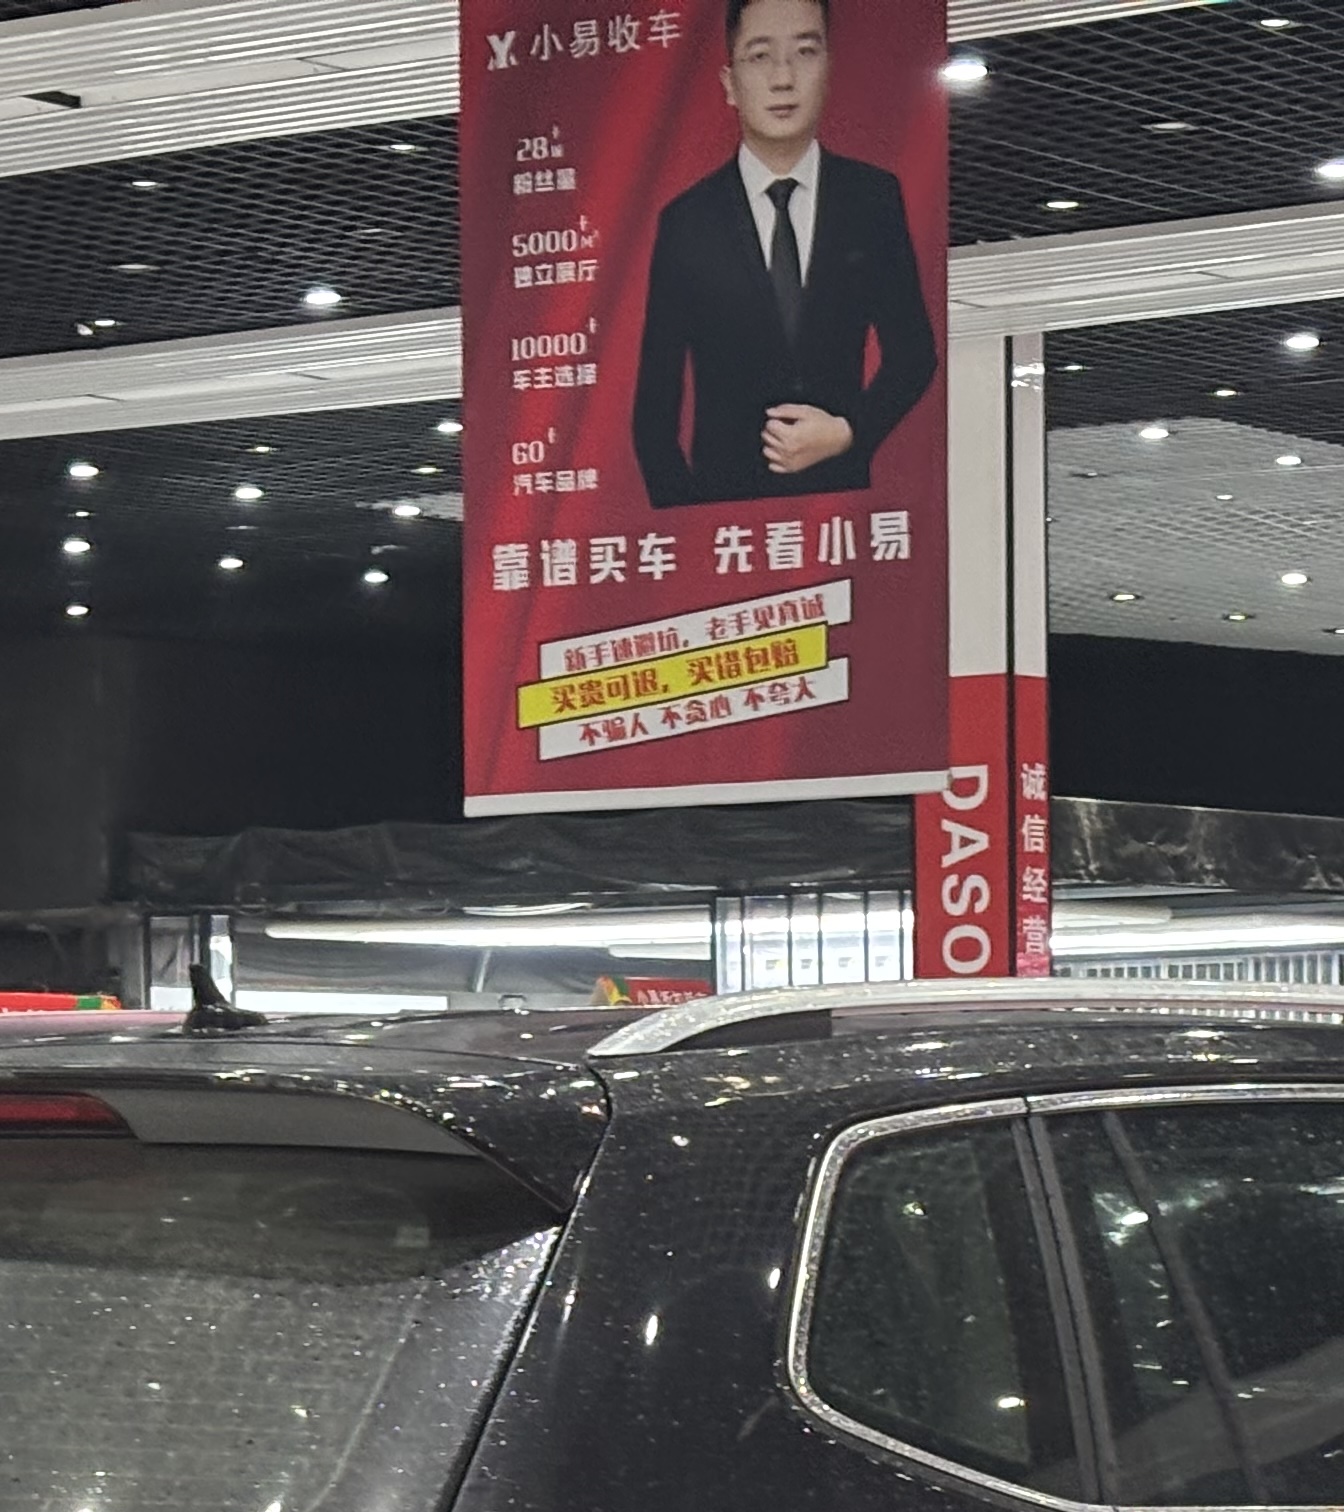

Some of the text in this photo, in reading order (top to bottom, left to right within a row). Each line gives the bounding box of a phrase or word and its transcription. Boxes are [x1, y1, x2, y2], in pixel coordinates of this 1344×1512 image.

[530, 9, 681, 61] 小易收车
[513, 363, 597, 390] 车主选择
[513, 468, 598, 496] 汽车品牌
[492, 510, 911, 591] 靠谱买车 先看小易
[941, 764, 991, 974] DASO
